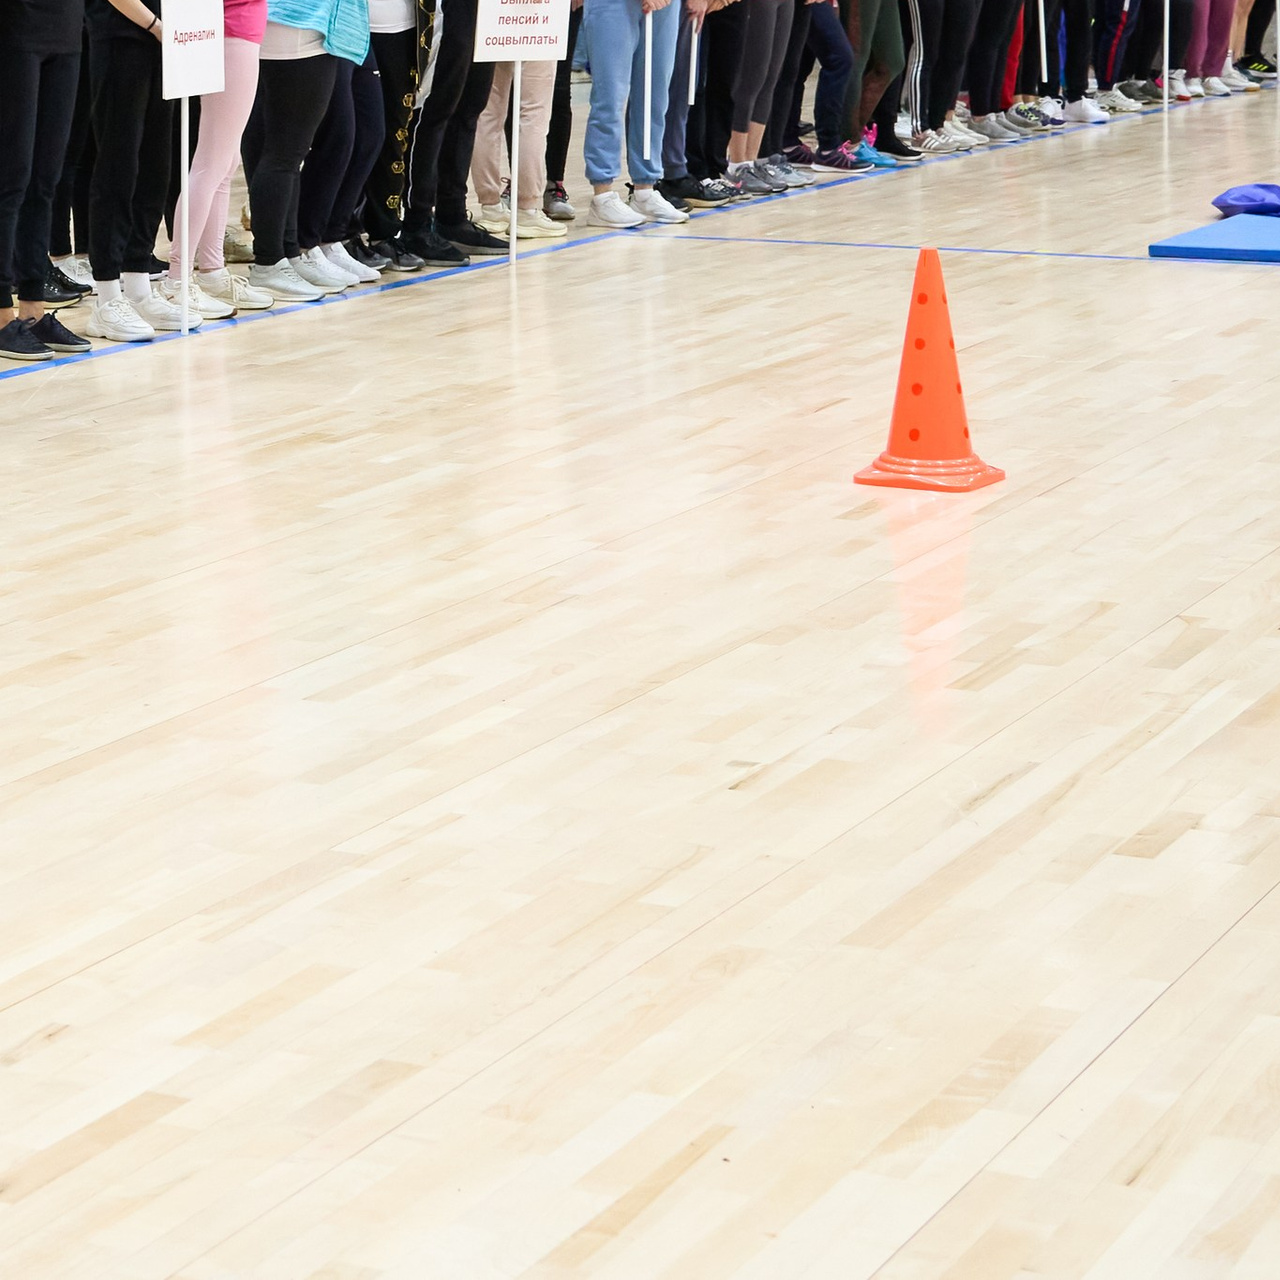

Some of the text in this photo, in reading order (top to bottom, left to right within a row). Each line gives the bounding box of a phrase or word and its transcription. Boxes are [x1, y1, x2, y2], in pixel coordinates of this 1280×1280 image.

[498, 13, 549, 25] пенсий и
[173, 29, 216, 45] Адреналин
[485, 35, 558, 47] соцвыплаты
